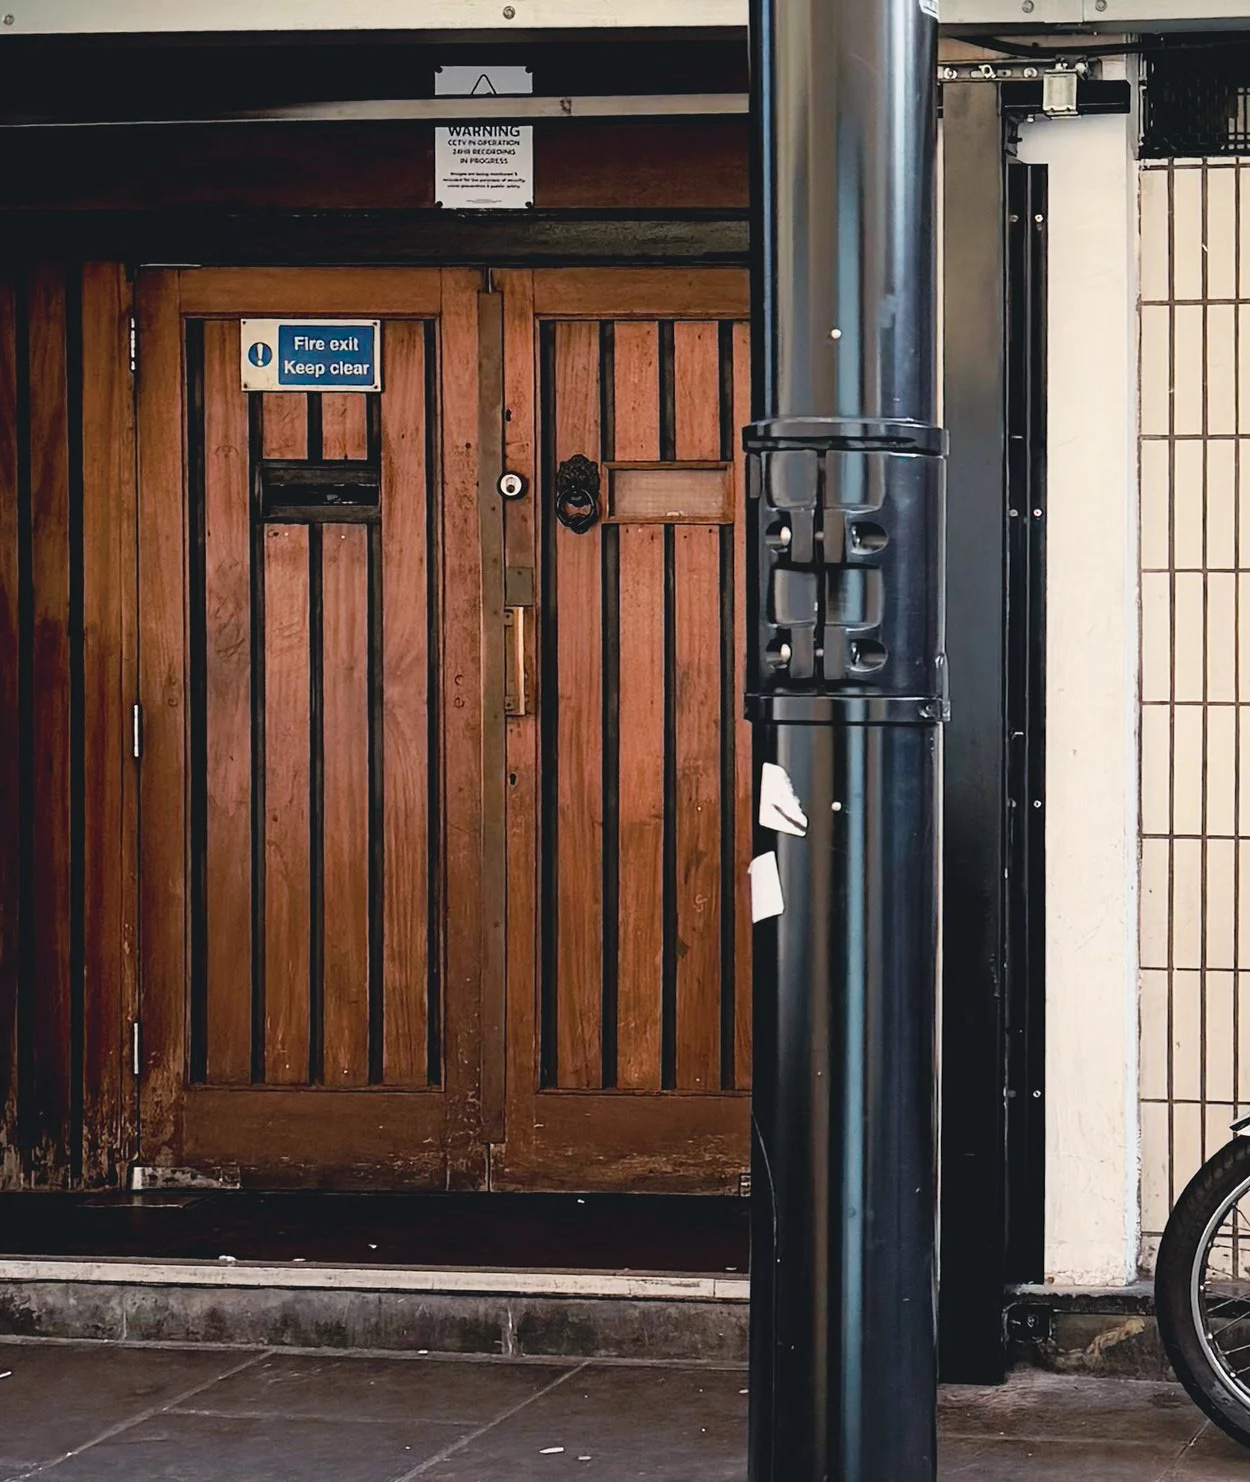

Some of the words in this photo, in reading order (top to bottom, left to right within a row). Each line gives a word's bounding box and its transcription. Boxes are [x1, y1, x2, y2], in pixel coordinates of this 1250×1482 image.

[448, 126, 520, 137] WARNING
[293, 336, 325, 351] Fire
[329, 336, 359, 351] exit
[283, 360, 325, 378] Keep
[329, 360, 370, 375] clear
